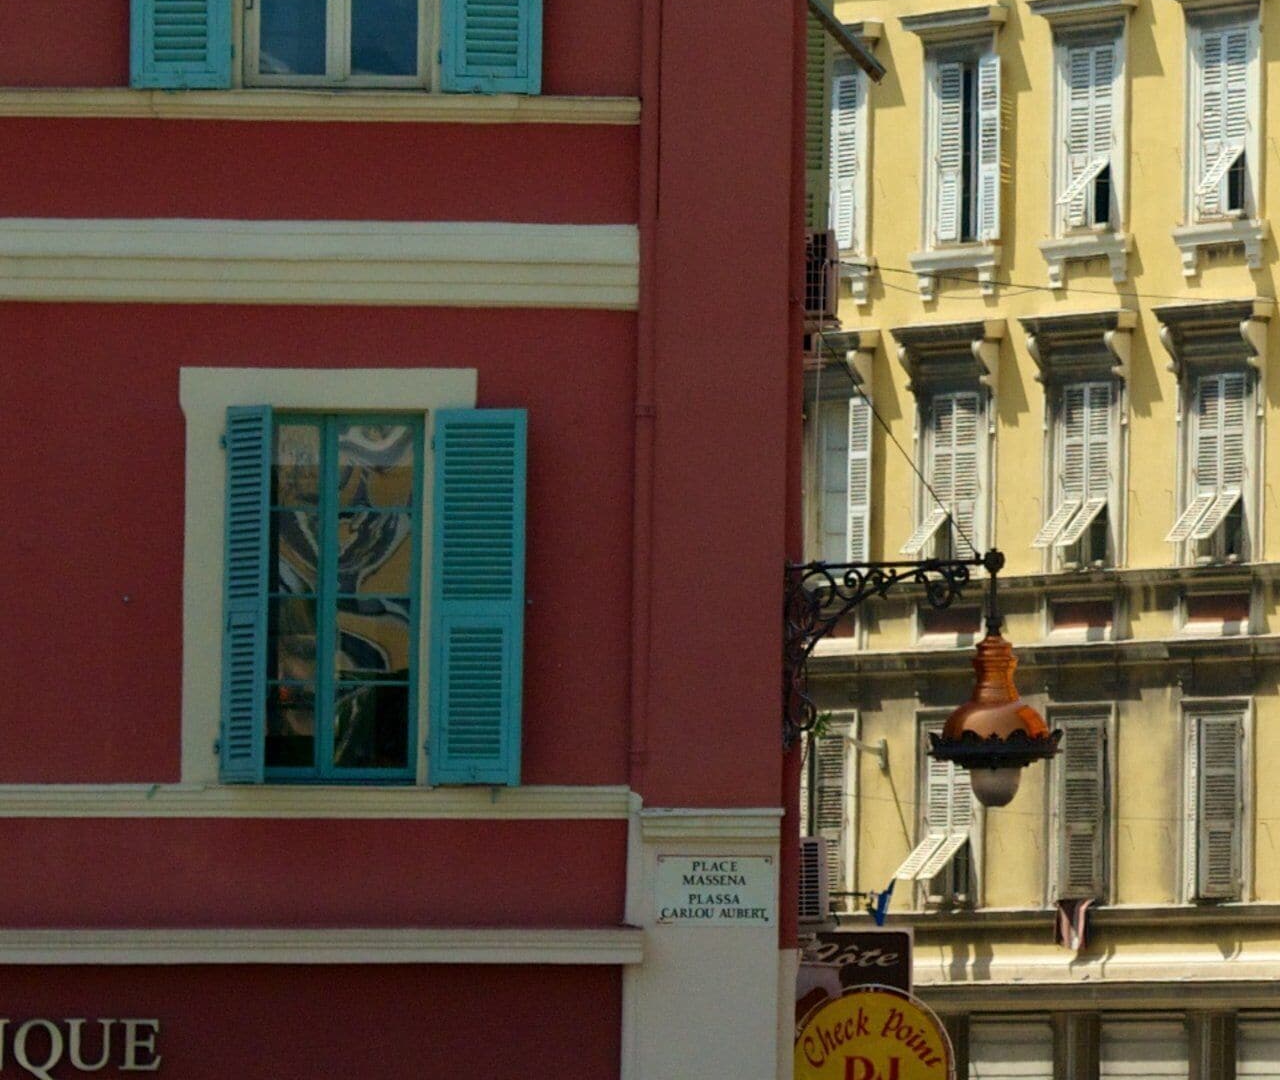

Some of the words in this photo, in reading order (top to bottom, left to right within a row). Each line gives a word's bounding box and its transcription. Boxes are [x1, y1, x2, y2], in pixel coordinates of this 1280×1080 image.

[692, 861, 738, 871] PLACE
[682, 875, 747, 886] MASSENA
[688, 894, 741, 905] PLASSA
[661, 908, 715, 919] CARLOU
[719, 908, 768, 919] AUBERT
[803, 1007, 871, 1068] Check
[880, 1007, 942, 1068] Point
[0, 1018, 161, 1080] QUE
